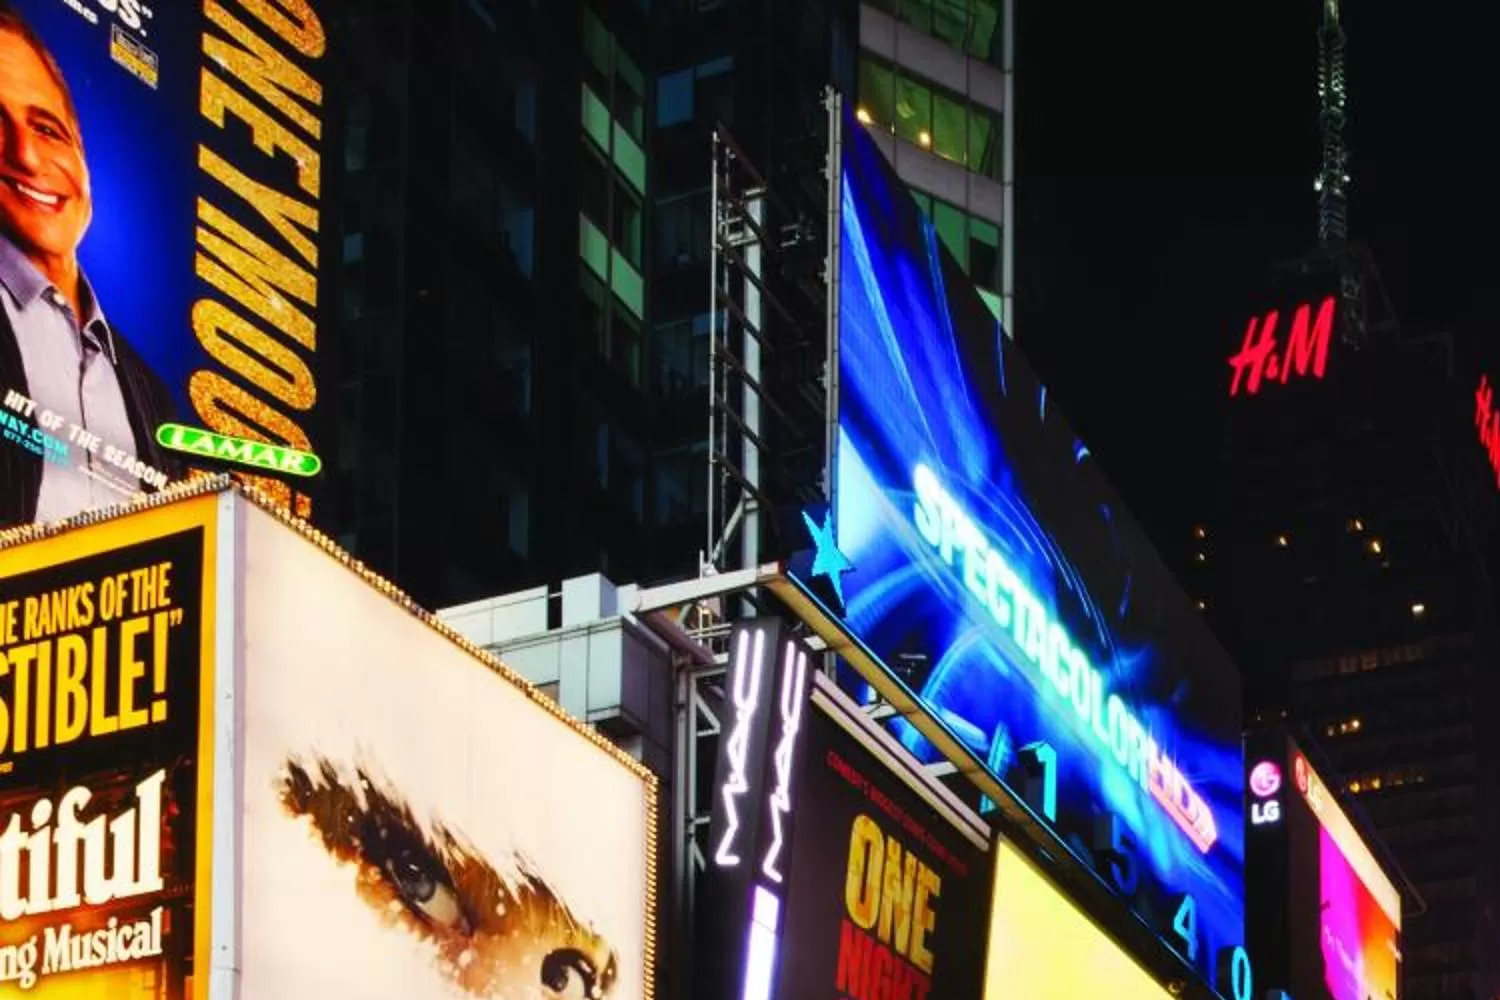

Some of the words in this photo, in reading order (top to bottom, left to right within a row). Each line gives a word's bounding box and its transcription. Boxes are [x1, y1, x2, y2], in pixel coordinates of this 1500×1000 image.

[1229, 296, 1336, 395] H&M
[5, 389, 35, 417] HIT
[39, 409, 64, 433] OF
[68, 421, 102, 452] THE
[171, 428, 305, 471] LAMAR
[24, 582, 95, 641] RANKS
[100, 576, 129, 621] OF
[130, 561, 173, 614] THE
[1252, 801, 1281, 825] LG
[846, 814, 942, 975] ONE
[41, 906, 163, 975] Musical
